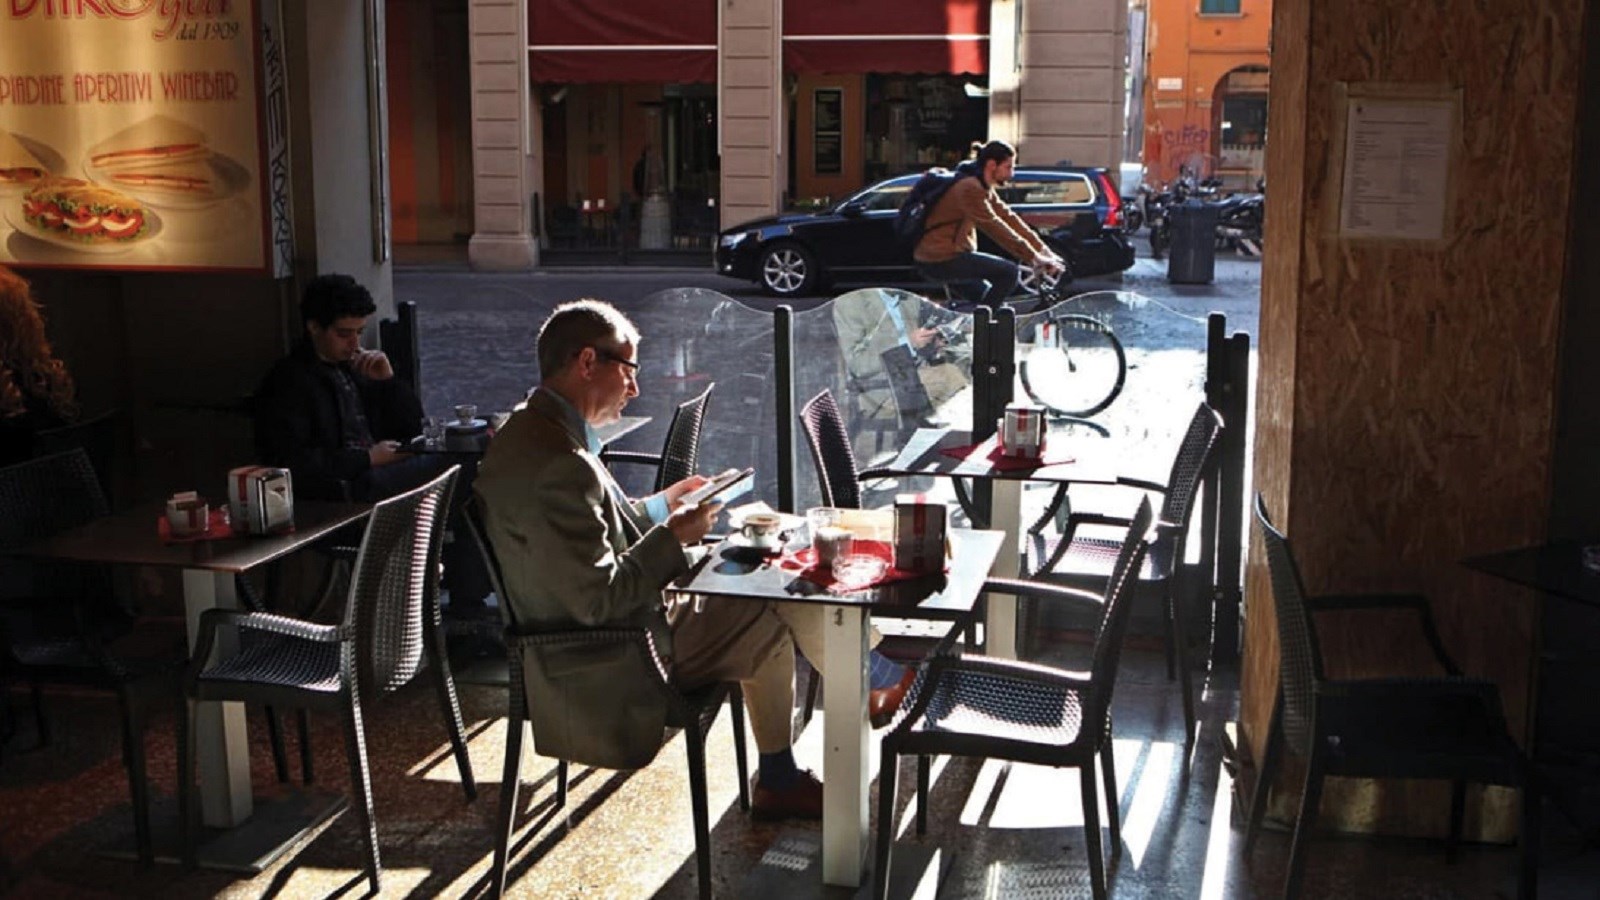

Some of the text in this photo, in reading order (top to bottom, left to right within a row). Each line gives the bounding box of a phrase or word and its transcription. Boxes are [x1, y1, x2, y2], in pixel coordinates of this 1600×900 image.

[176, 22, 240, 40] dal 1909
[0, 71, 239, 104] PIADINE APERITIVI WINEBAR
